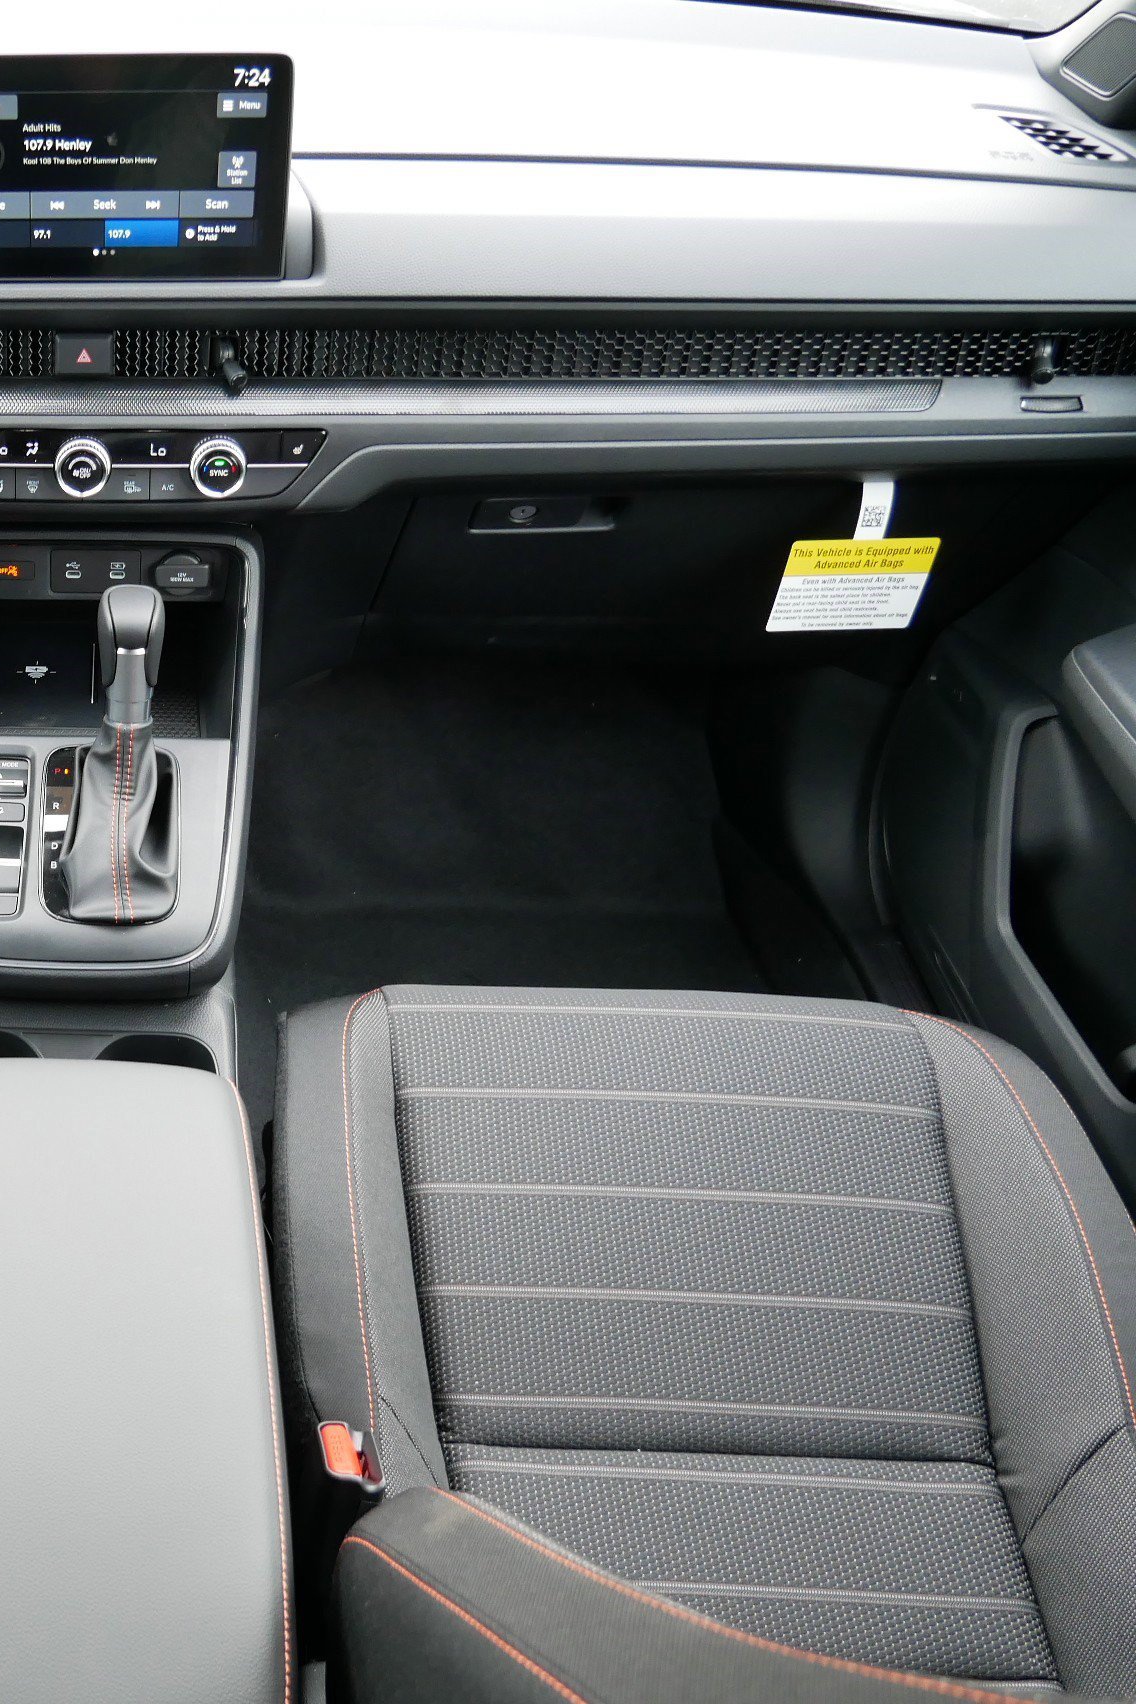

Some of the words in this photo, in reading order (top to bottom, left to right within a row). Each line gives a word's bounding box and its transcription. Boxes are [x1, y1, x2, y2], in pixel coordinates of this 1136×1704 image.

[234, 68, 271, 87] 7:24
[239, 101, 261, 110] Menu
[22, 123, 44, 132] Adult
[45, 123, 61, 132] Hits
[23, 139, 53, 151] 107.9
[55, 139, 92, 152] Henley
[53, 157, 65, 165] The
[134, 156, 157, 166] Henley
[226, 169, 248, 178] Station
[231, 177, 242, 185] List
[93, 199, 117, 210] Seek
[205, 198, 229, 210] Scan
[33, 230, 52, 240] 97.1
[108, 229, 131, 239] 107.9
[150, 443, 166, 456] Lo
[210, 470, 228, 478] SYNC
[794, 548, 813, 558] This
[817, 548, 852, 557] Vehicle
[855, 547, 864, 556] is
[866, 546, 911, 556] Equipped
[914, 546, 934, 554] with
[814, 560, 861, 569] Advanced
[864, 559, 878, 568] Air
[880, 559, 904, 569] Bags
[50, 861, 58, 869] B
